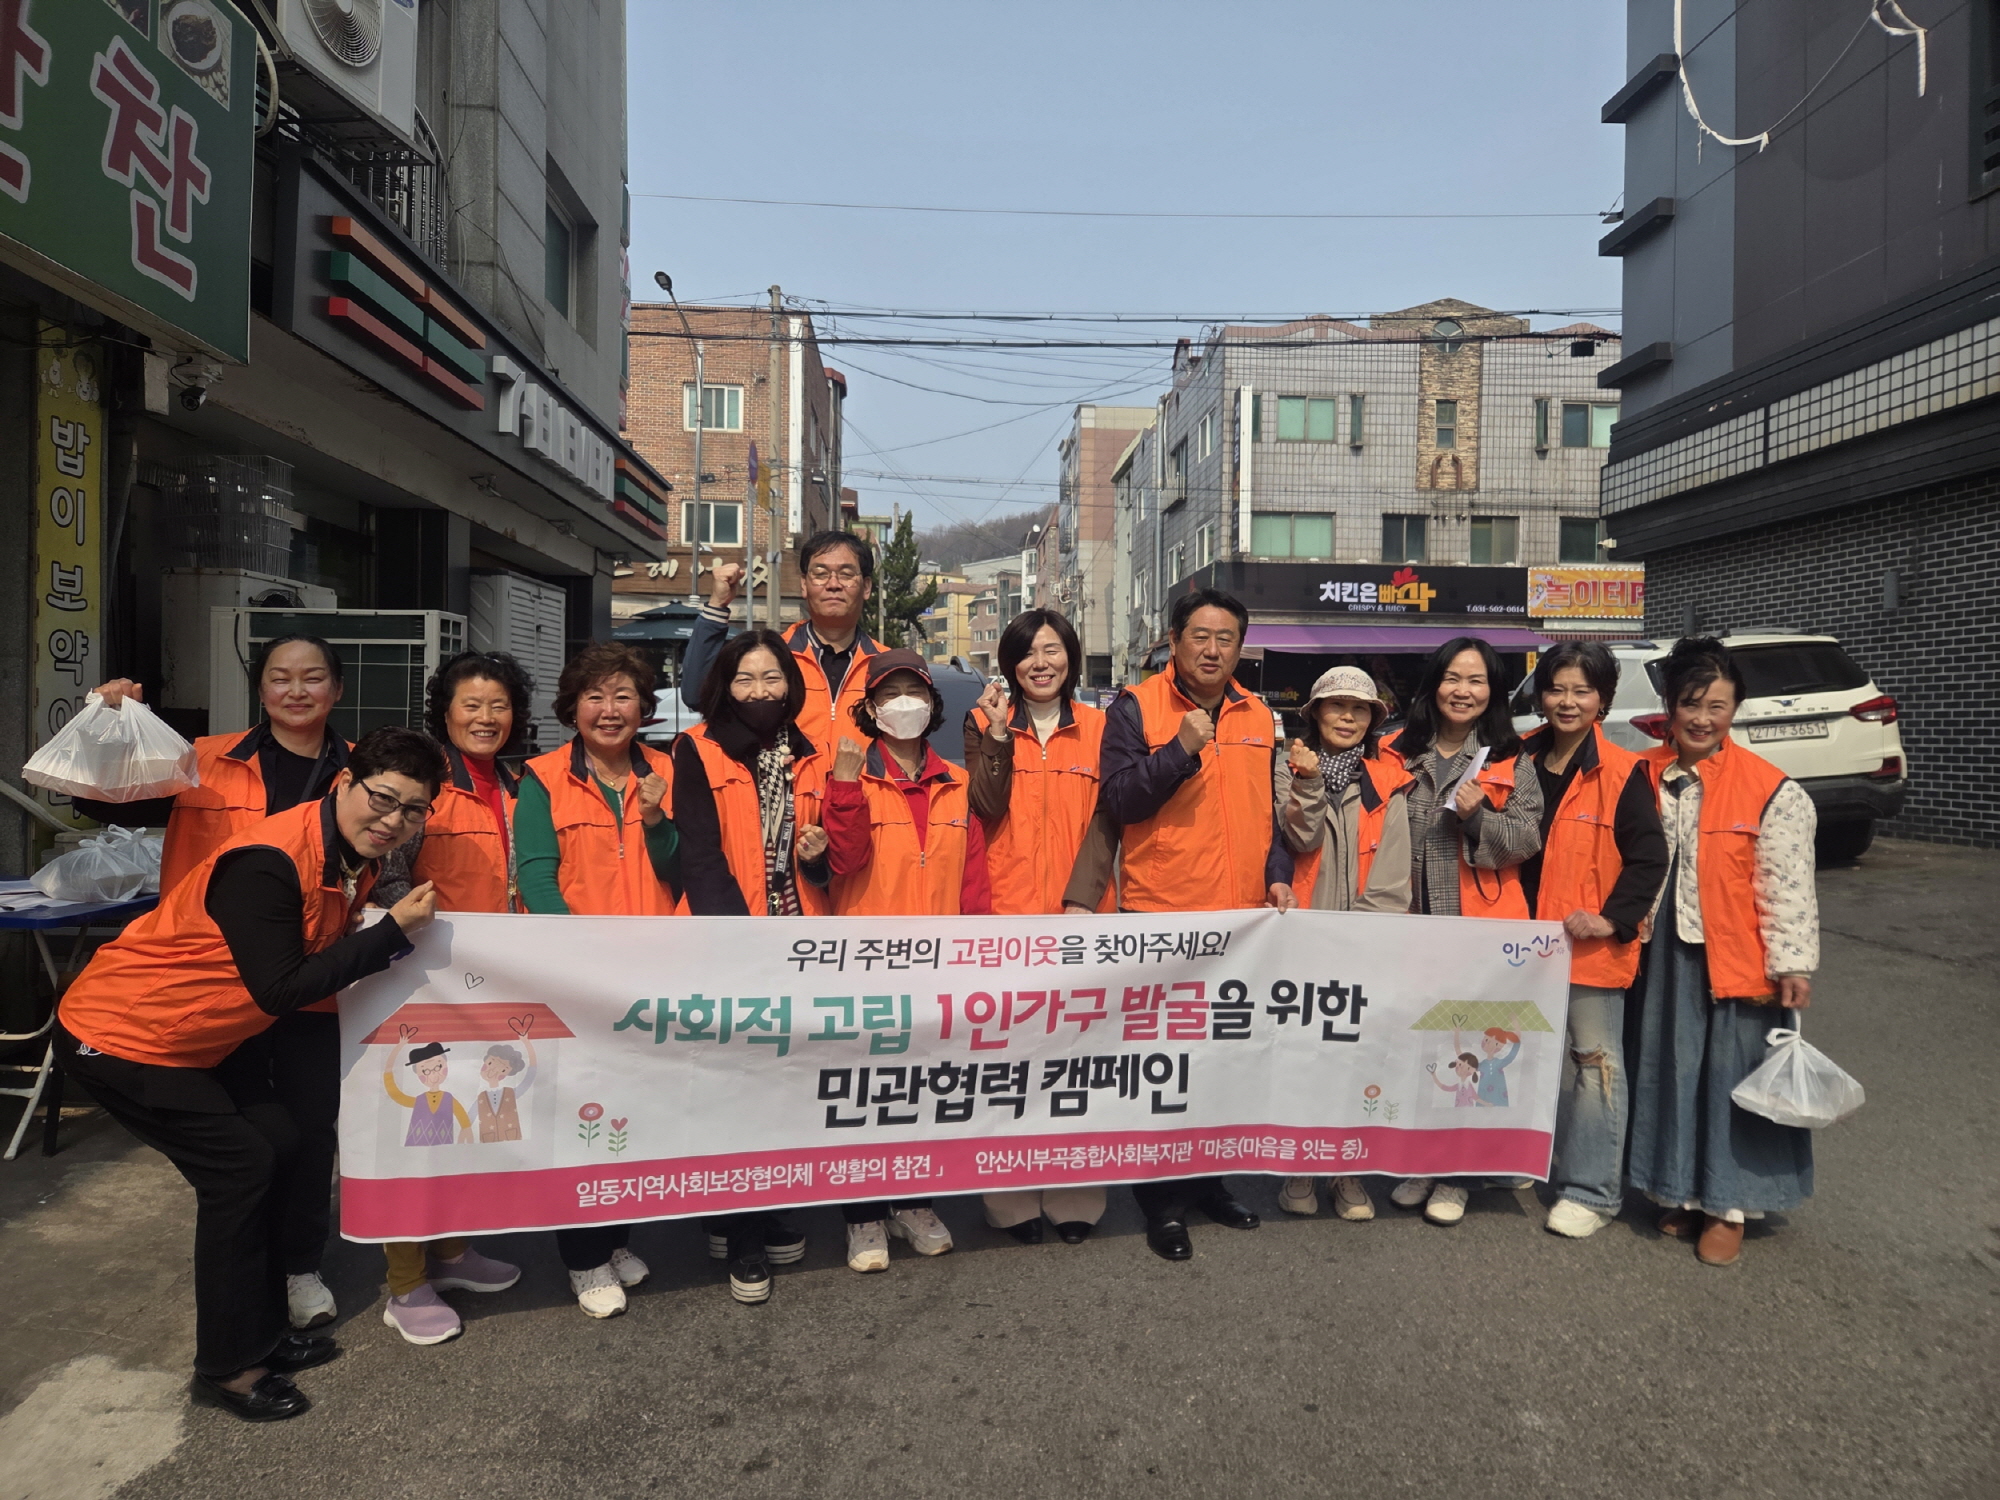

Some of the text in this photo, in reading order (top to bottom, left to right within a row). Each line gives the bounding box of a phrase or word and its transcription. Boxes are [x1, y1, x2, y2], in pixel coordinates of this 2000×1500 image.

[787, 930, 1231, 972] 우리 주변의 고립이웃을 찾아주세요!
[613, 993, 792, 1057] 사회적
[808, 994, 912, 1055] 고립
[1120, 978, 1255, 1041] 발굴을
[1266, 978, 1368, 1042] 위한
[817, 1052, 1189, 1129] 민관협력 캠페인
[975, 1141, 1193, 1175] 안산시부곡종합사회복지관
[1302, 1137, 1337, 1162] 잇는
[576, 1162, 813, 1208] 일동지역사회보장협의체
